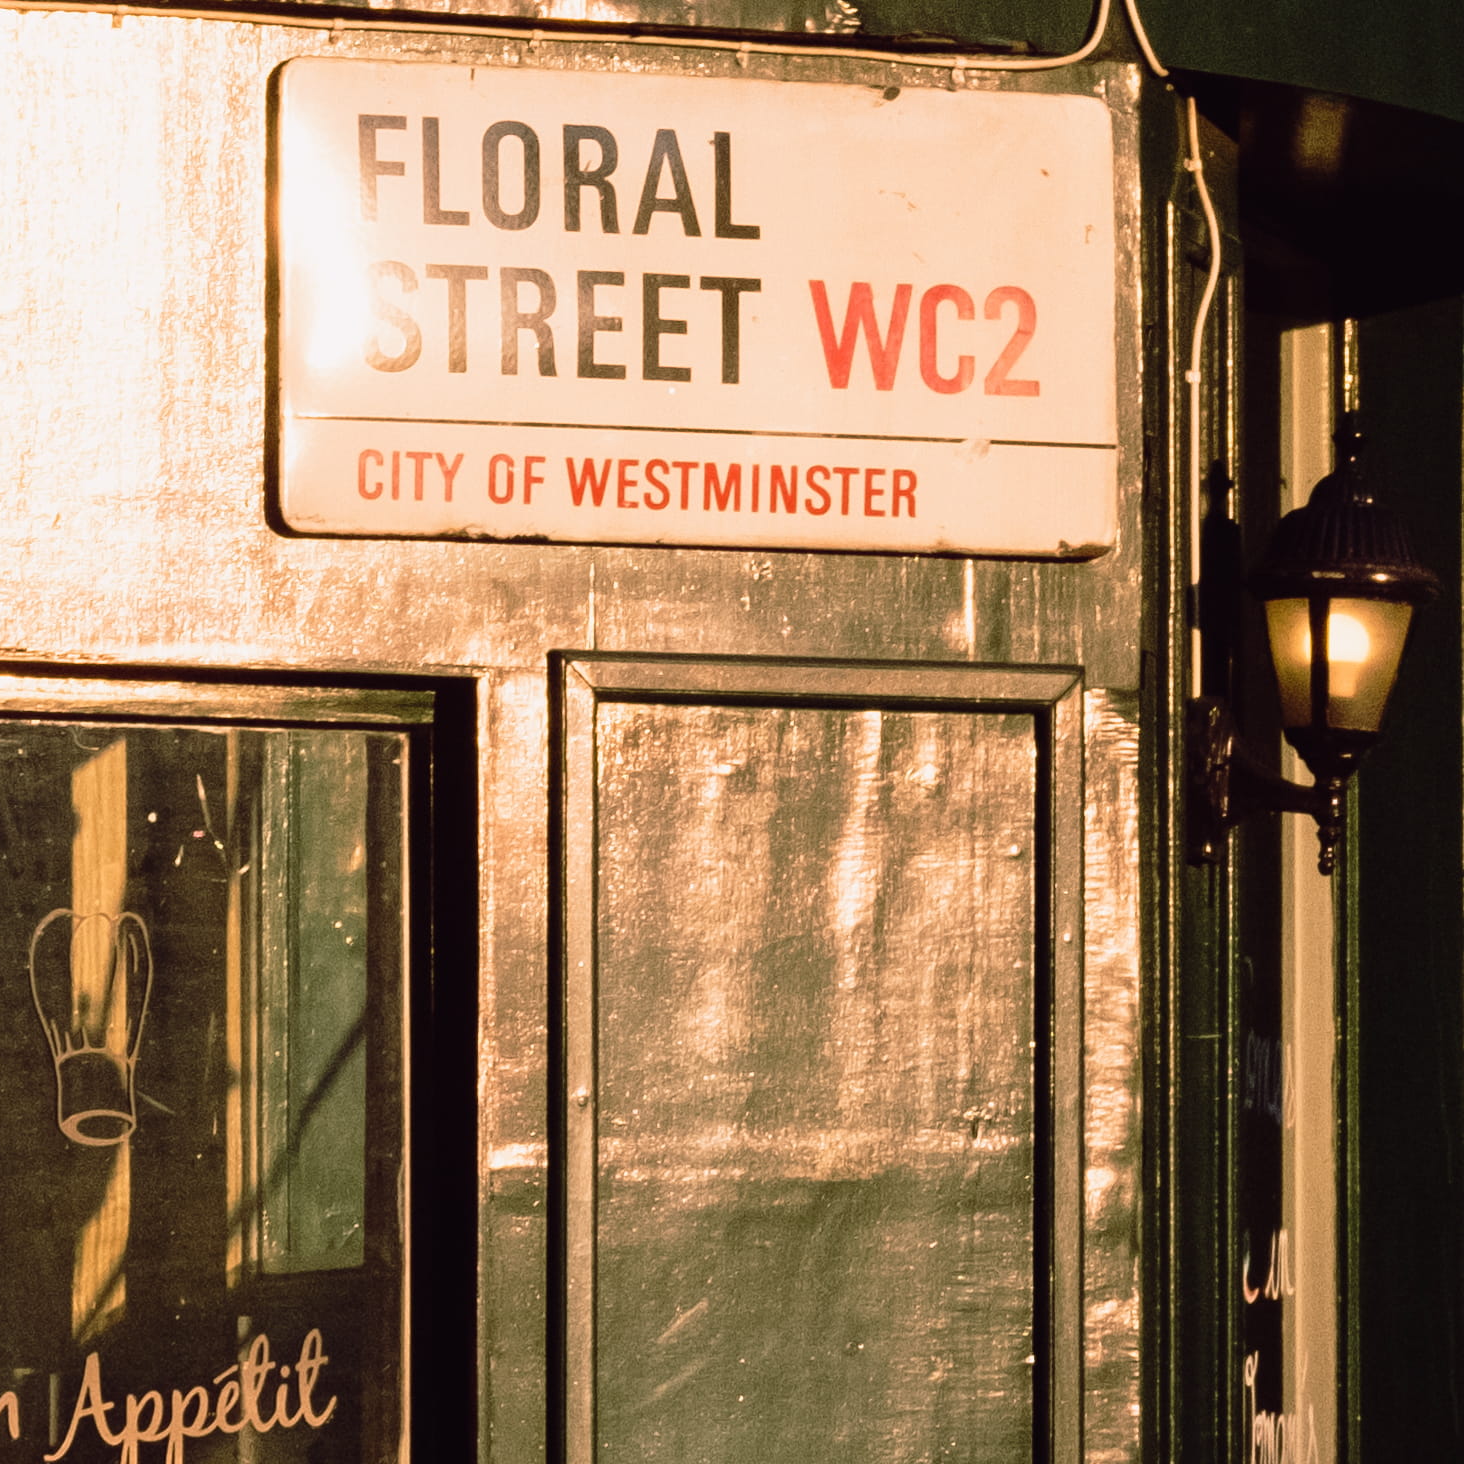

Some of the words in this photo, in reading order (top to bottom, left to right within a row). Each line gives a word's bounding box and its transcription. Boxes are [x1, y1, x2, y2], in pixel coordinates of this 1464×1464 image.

[356, 113, 762, 241] FLORAL
[361, 260, 762, 386] STREET
[808, 278, 1041, 398] WC2
[357, 449, 465, 502] CITY
[487, 453, 547, 506] OF
[565, 457, 919, 519] WESTMINSTER
